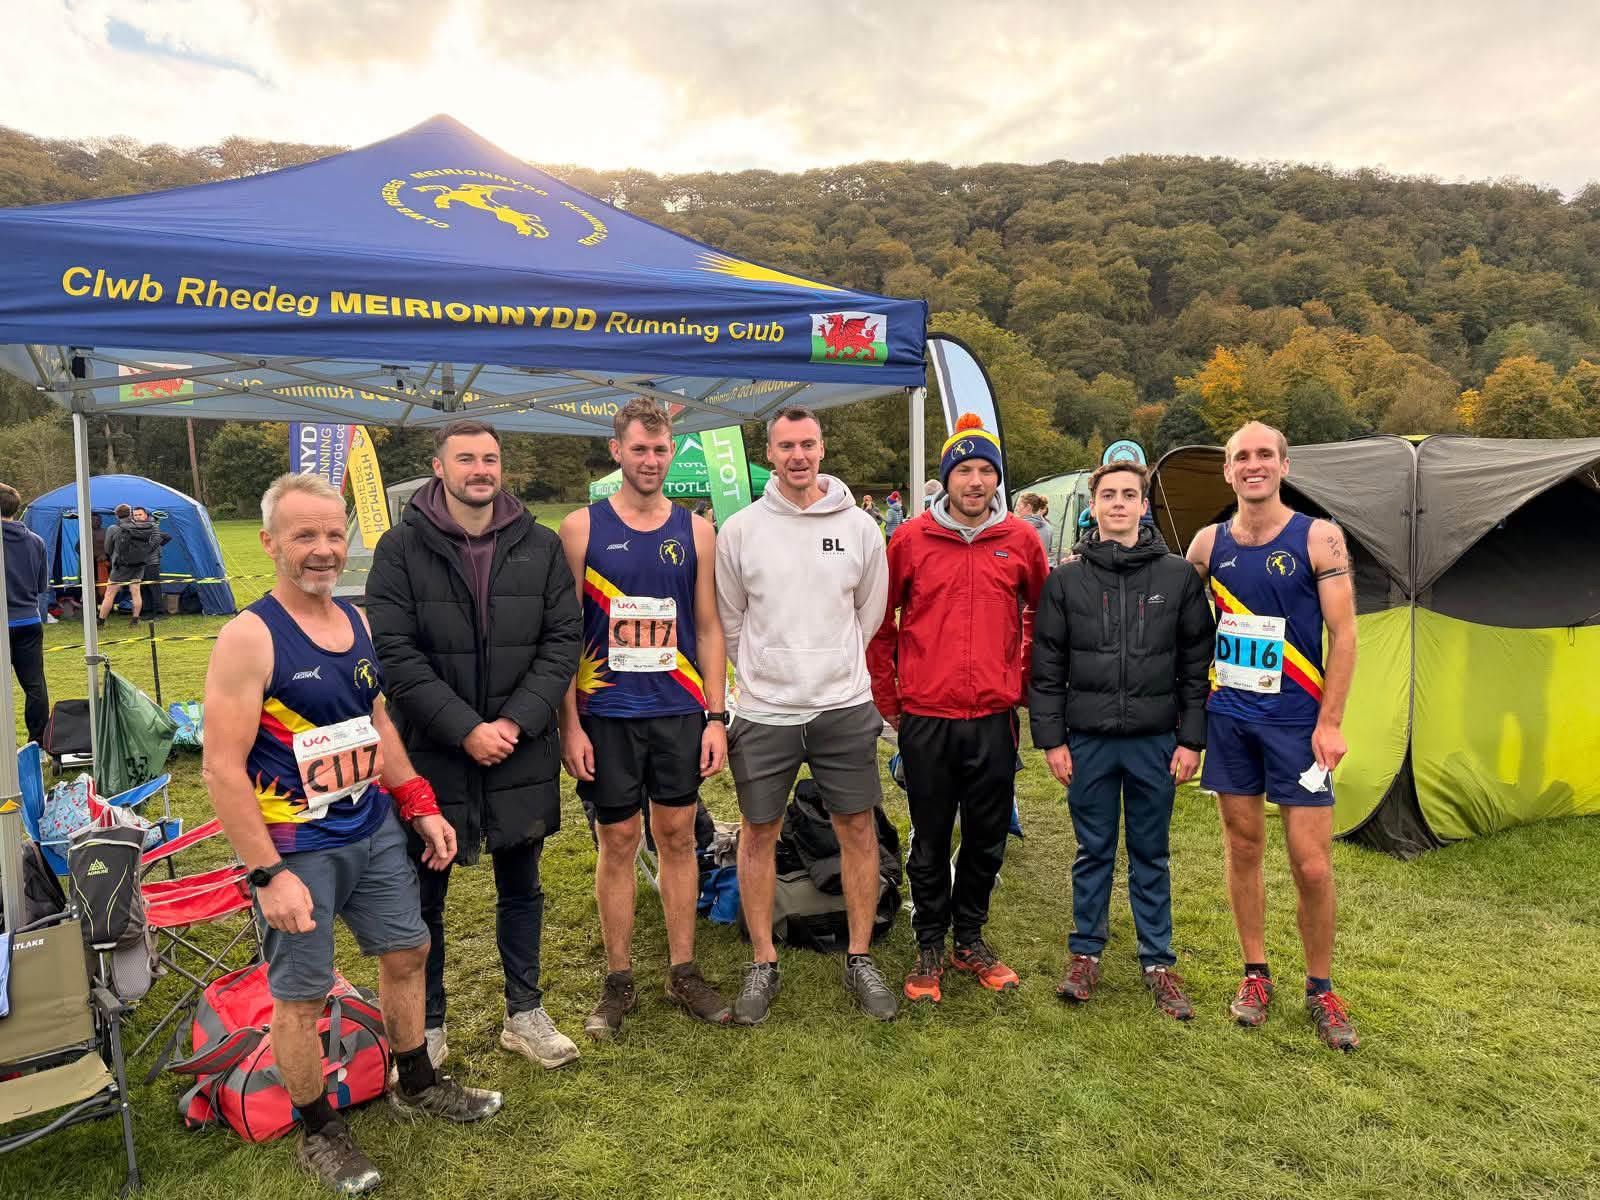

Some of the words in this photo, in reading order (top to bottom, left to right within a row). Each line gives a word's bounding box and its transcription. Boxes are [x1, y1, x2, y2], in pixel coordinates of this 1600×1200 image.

[62, 266, 164, 303] Clwb
[176, 276, 319, 317] Rhedeg
[330, 291, 597, 331] MEIRIONNYDD
[604, 311, 719, 343] Running
[728, 321, 785, 342] Club
[822, 538, 845, 552] BL
[613, 620, 674, 647] C117
[1217, 634, 1278, 669] D116
[306, 744, 379, 793] C117
